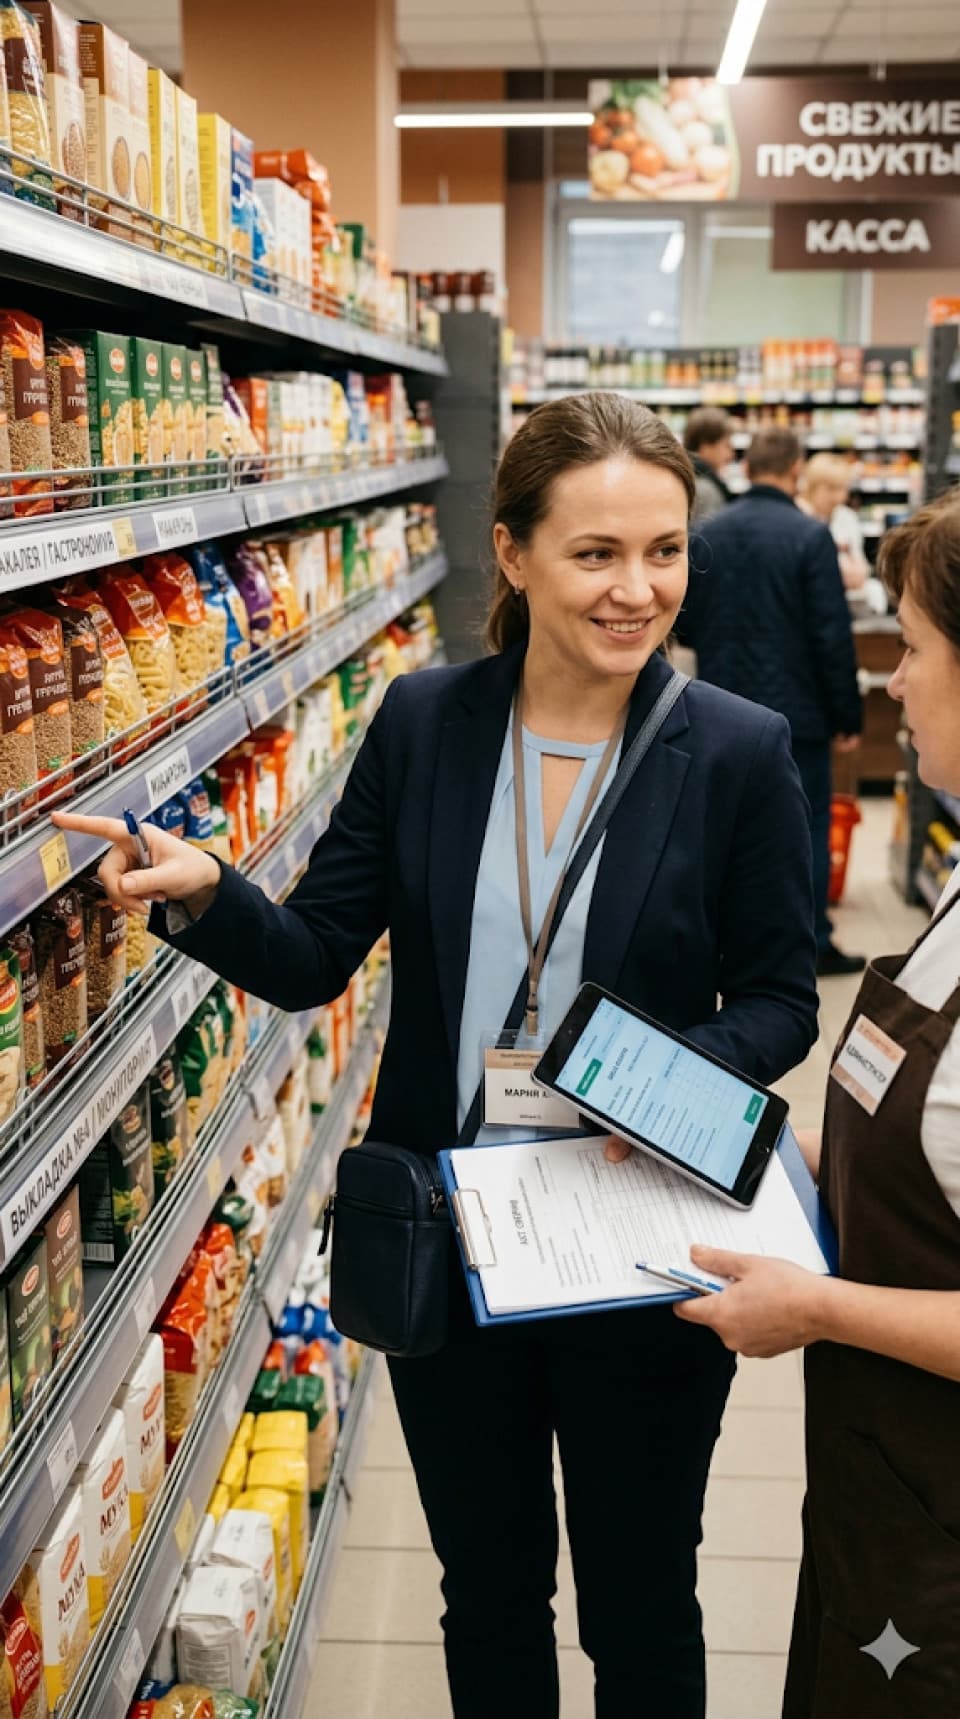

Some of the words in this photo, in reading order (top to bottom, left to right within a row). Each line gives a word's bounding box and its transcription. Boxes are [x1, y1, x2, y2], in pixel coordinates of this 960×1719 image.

[799, 102, 960, 136] СВЕЖИЕ
[756, 143, 960, 182] ПРОДУКТЫ
[805, 219, 931, 252] КАССА
[10, 1141, 73, 1238] ВЫКЛАДКА
